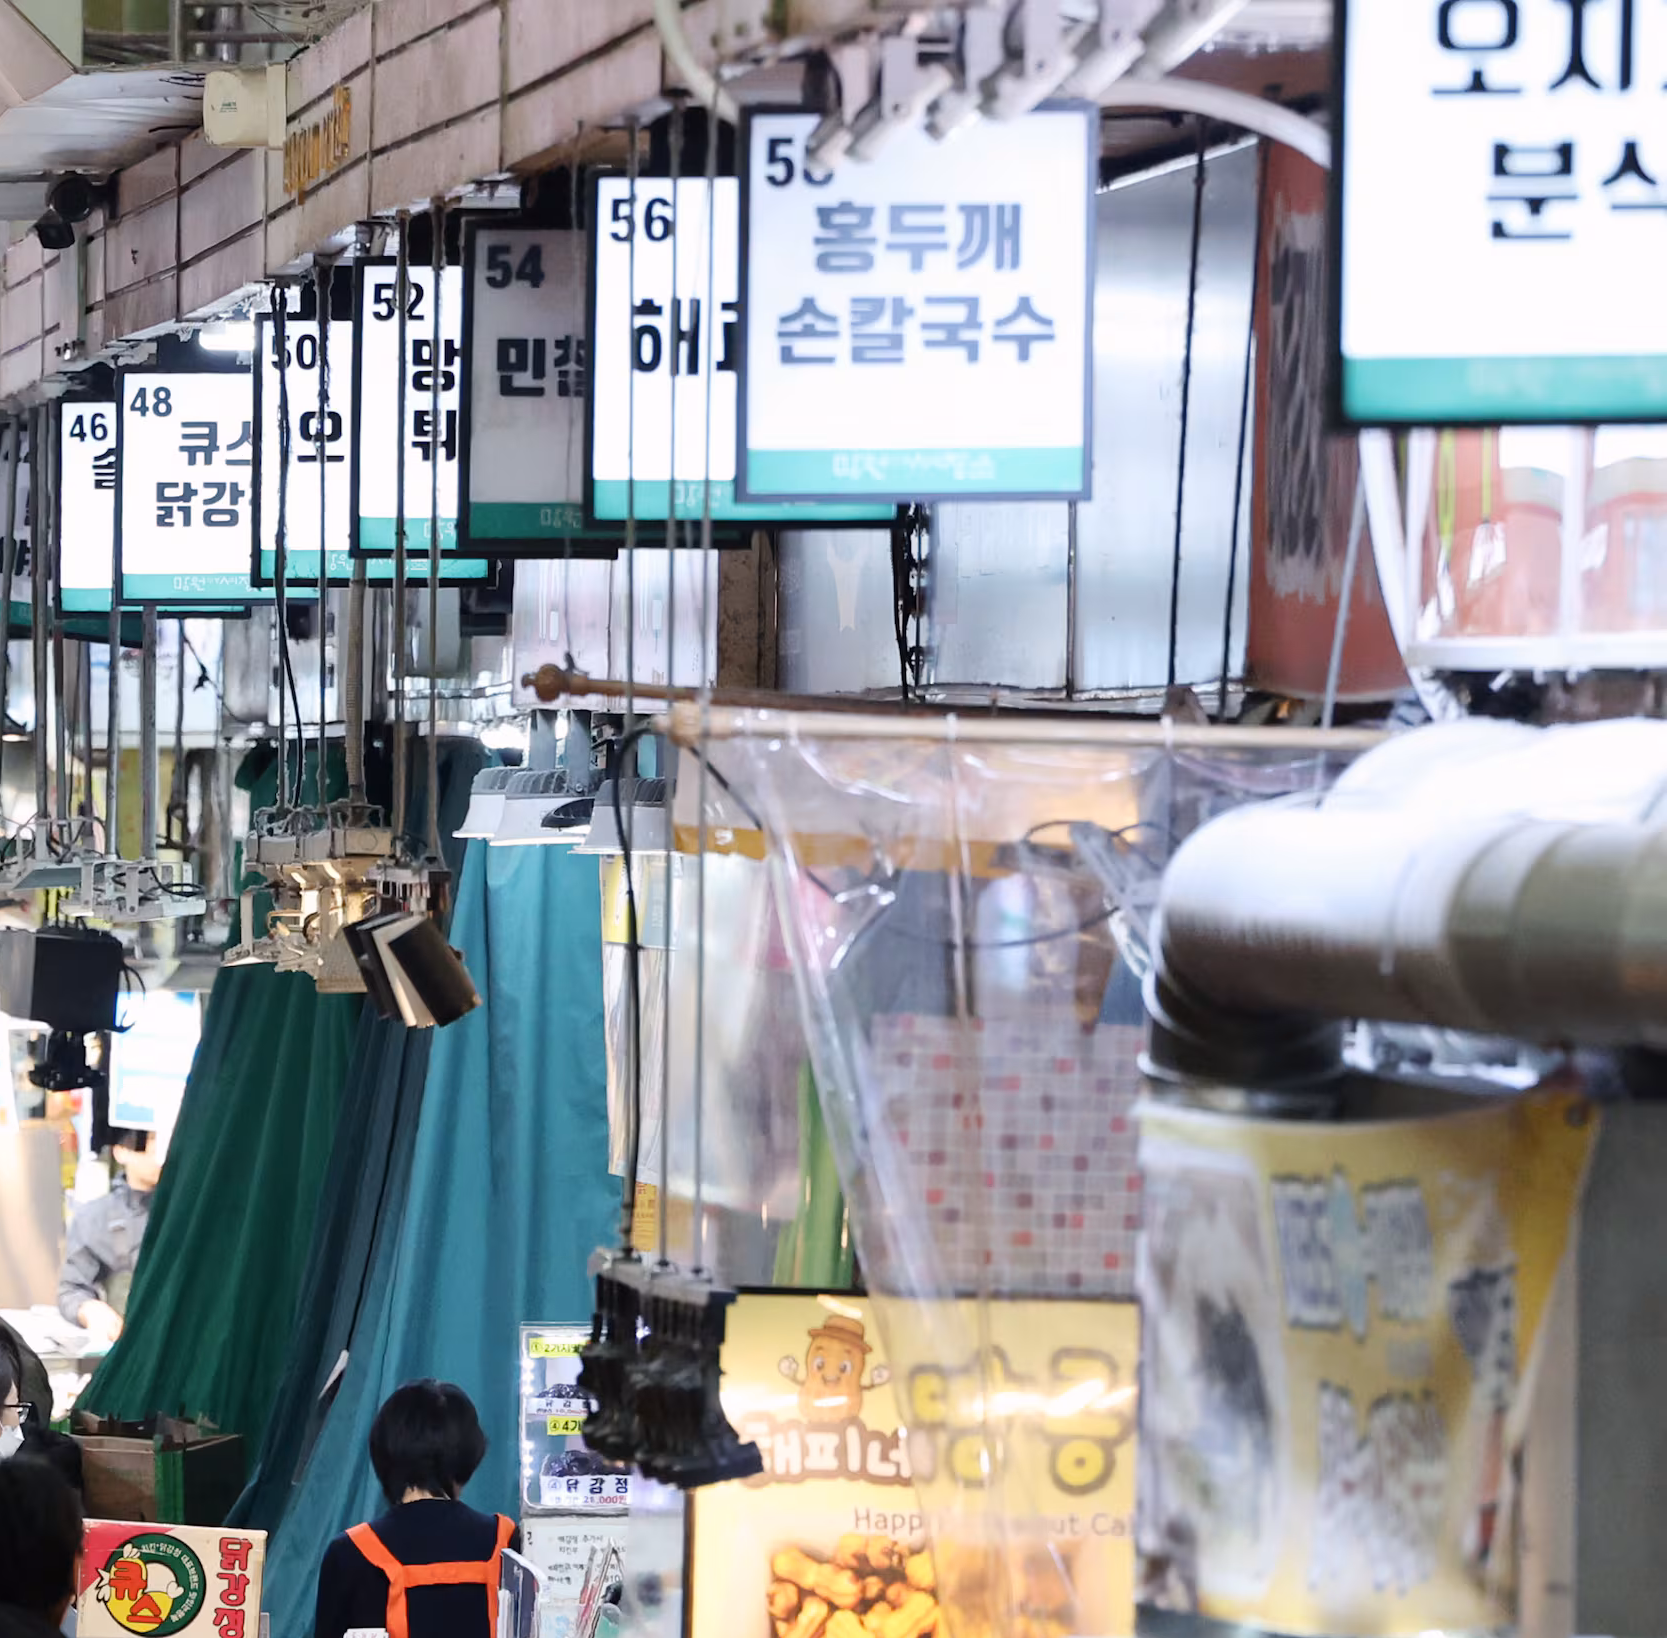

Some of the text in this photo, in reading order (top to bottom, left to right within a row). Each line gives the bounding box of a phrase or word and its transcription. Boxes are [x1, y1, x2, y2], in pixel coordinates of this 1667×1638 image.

[610, 198, 674, 242] 56
[813, 200, 1023, 274] 홍두깨
[485, 243, 545, 289] 54
[372, 282, 425, 321] 52
[270, 334, 318, 371] 50
[631, 298, 739, 377] 해
[776, 295, 1056, 367] 손칼국수
[129, 386, 172, 417] 48
[69, 412, 108, 443] 46
[178, 420, 254, 467] 큐스
[155, 482, 254, 529] 닭강
[854, 1507, 923, 1536] Happ
[108, 1559, 165, 1625] 큐스
